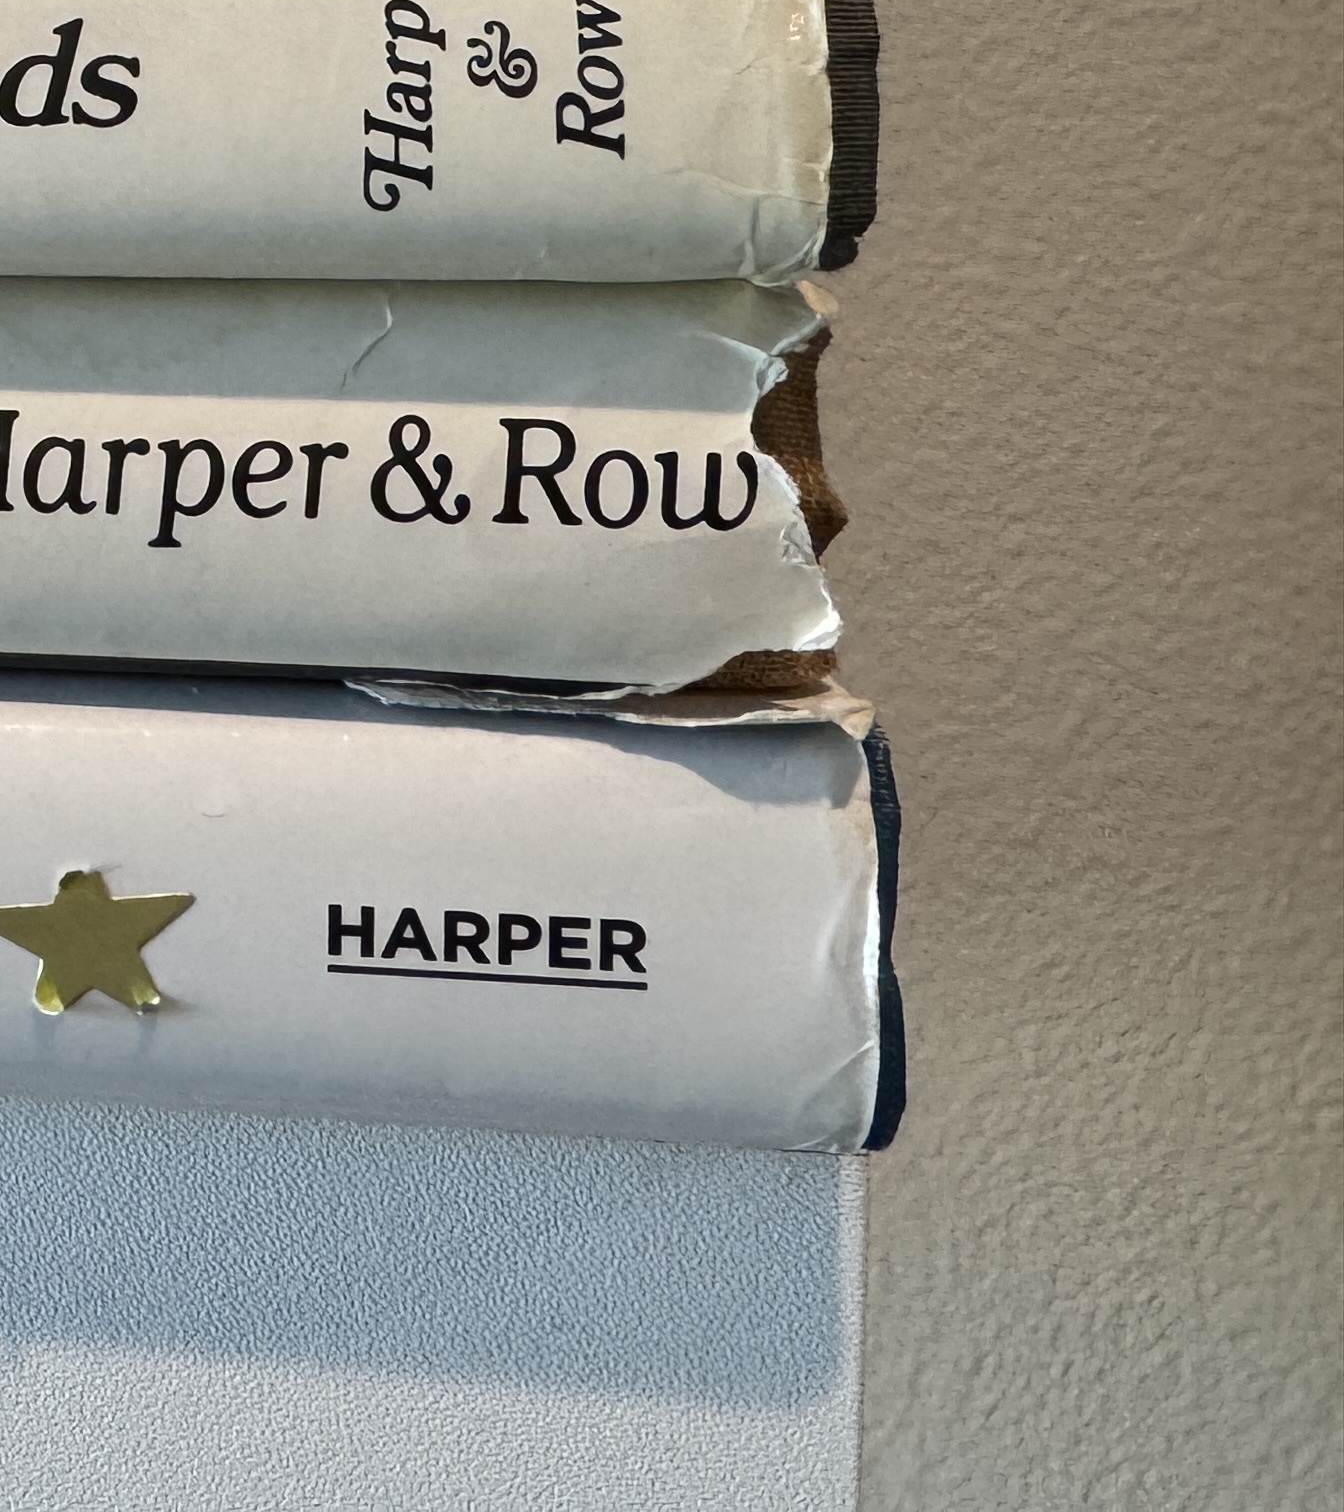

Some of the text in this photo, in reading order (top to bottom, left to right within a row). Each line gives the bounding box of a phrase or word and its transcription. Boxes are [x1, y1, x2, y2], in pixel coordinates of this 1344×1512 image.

[467, 21, 537, 98] &
[371, 415, 470, 524] &
[492, 417, 759, 532] Row
[327, 904, 647, 974] HARPER
